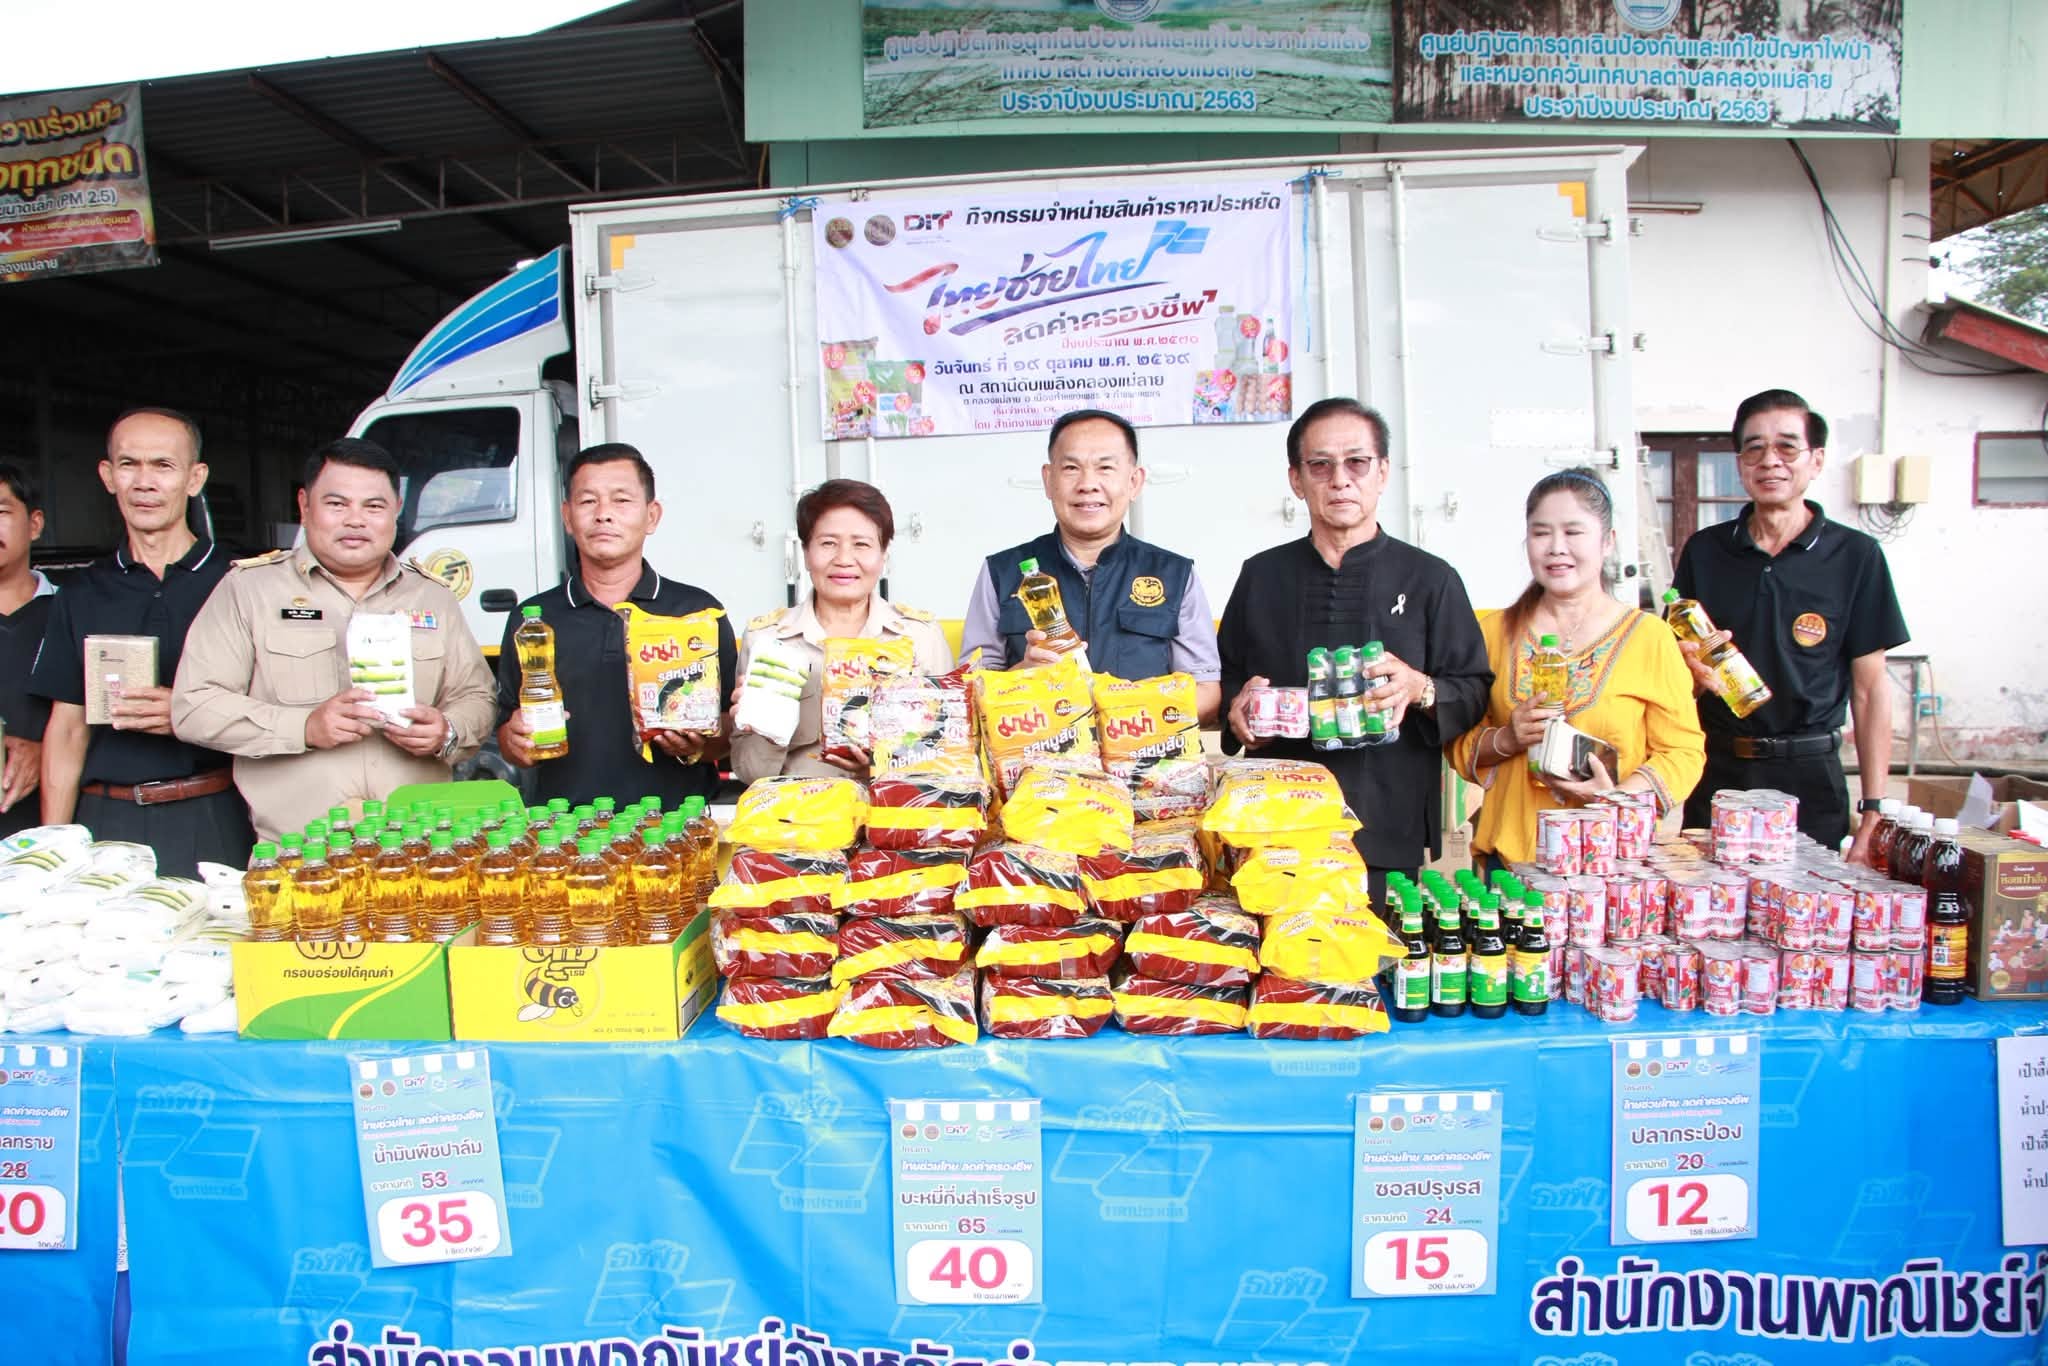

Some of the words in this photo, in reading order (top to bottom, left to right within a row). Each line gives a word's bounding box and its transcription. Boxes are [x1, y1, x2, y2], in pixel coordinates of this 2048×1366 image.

[1420, 30, 1873, 60] ศูนย์ปฏิบัติการฉุกเฉินป้องกันและแก้ไขปัญหาไฟป่า
[1460, 61, 1833, 89] และหมอกควันเทศบาลตำบลคลองแม่ลาย
[1002, 86, 1195, 111] ประจำปีงบประมาณ
[1203, 89, 1256, 109] 2563
[1525, 92, 1711, 119] ประจำปีงบประมาณ
[1719, 100, 1770, 120] 2563
[965, 190, 1281, 227] กิจกรรมจำหน่ายสินค้าราคาประหยัด
[1003, 289, 1218, 346] ลดค่าครองชีพ
[933, 356, 991, 376] วันจันทร์
[996, 352, 1008, 371] ที่
[1013, 356, 1041, 371] ๑๙
[1045, 356, 1093, 374] ตุลาคม
[1098, 355, 1131, 368] พ.ศ.
[958, 383, 975, 395] ณ
[980, 372, 1165, 394] สถานีดับเพลิงคลองแม่ลาย
[283, 965, 394, 981] กรอบอร่อยได้คุณค่า
[1631, 1121, 1742, 1145] ปลากระป๋อง
[374, 1138, 483, 1164] น้ำมันพืชปาล์ม
[1676, 1153, 1704, 1170] 20
[3, 1162, 29, 1178] 28
[421, 1171, 449, 1189] 53
[901, 1185, 1036, 1210] บะหมี่กึ่งสำเร็จรูป
[1375, 1180, 1481, 1201] ซอสปรุงรส
[0, 1191, 46, 1236] 0
[1425, 1207, 1452, 1225] 24
[1647, 1181, 1709, 1227] 12
[400, 1198, 473, 1248] 35
[958, 1217, 987, 1234] 65
[928, 1246, 1008, 1289] 40
[1385, 1236, 1450, 1281] 15
